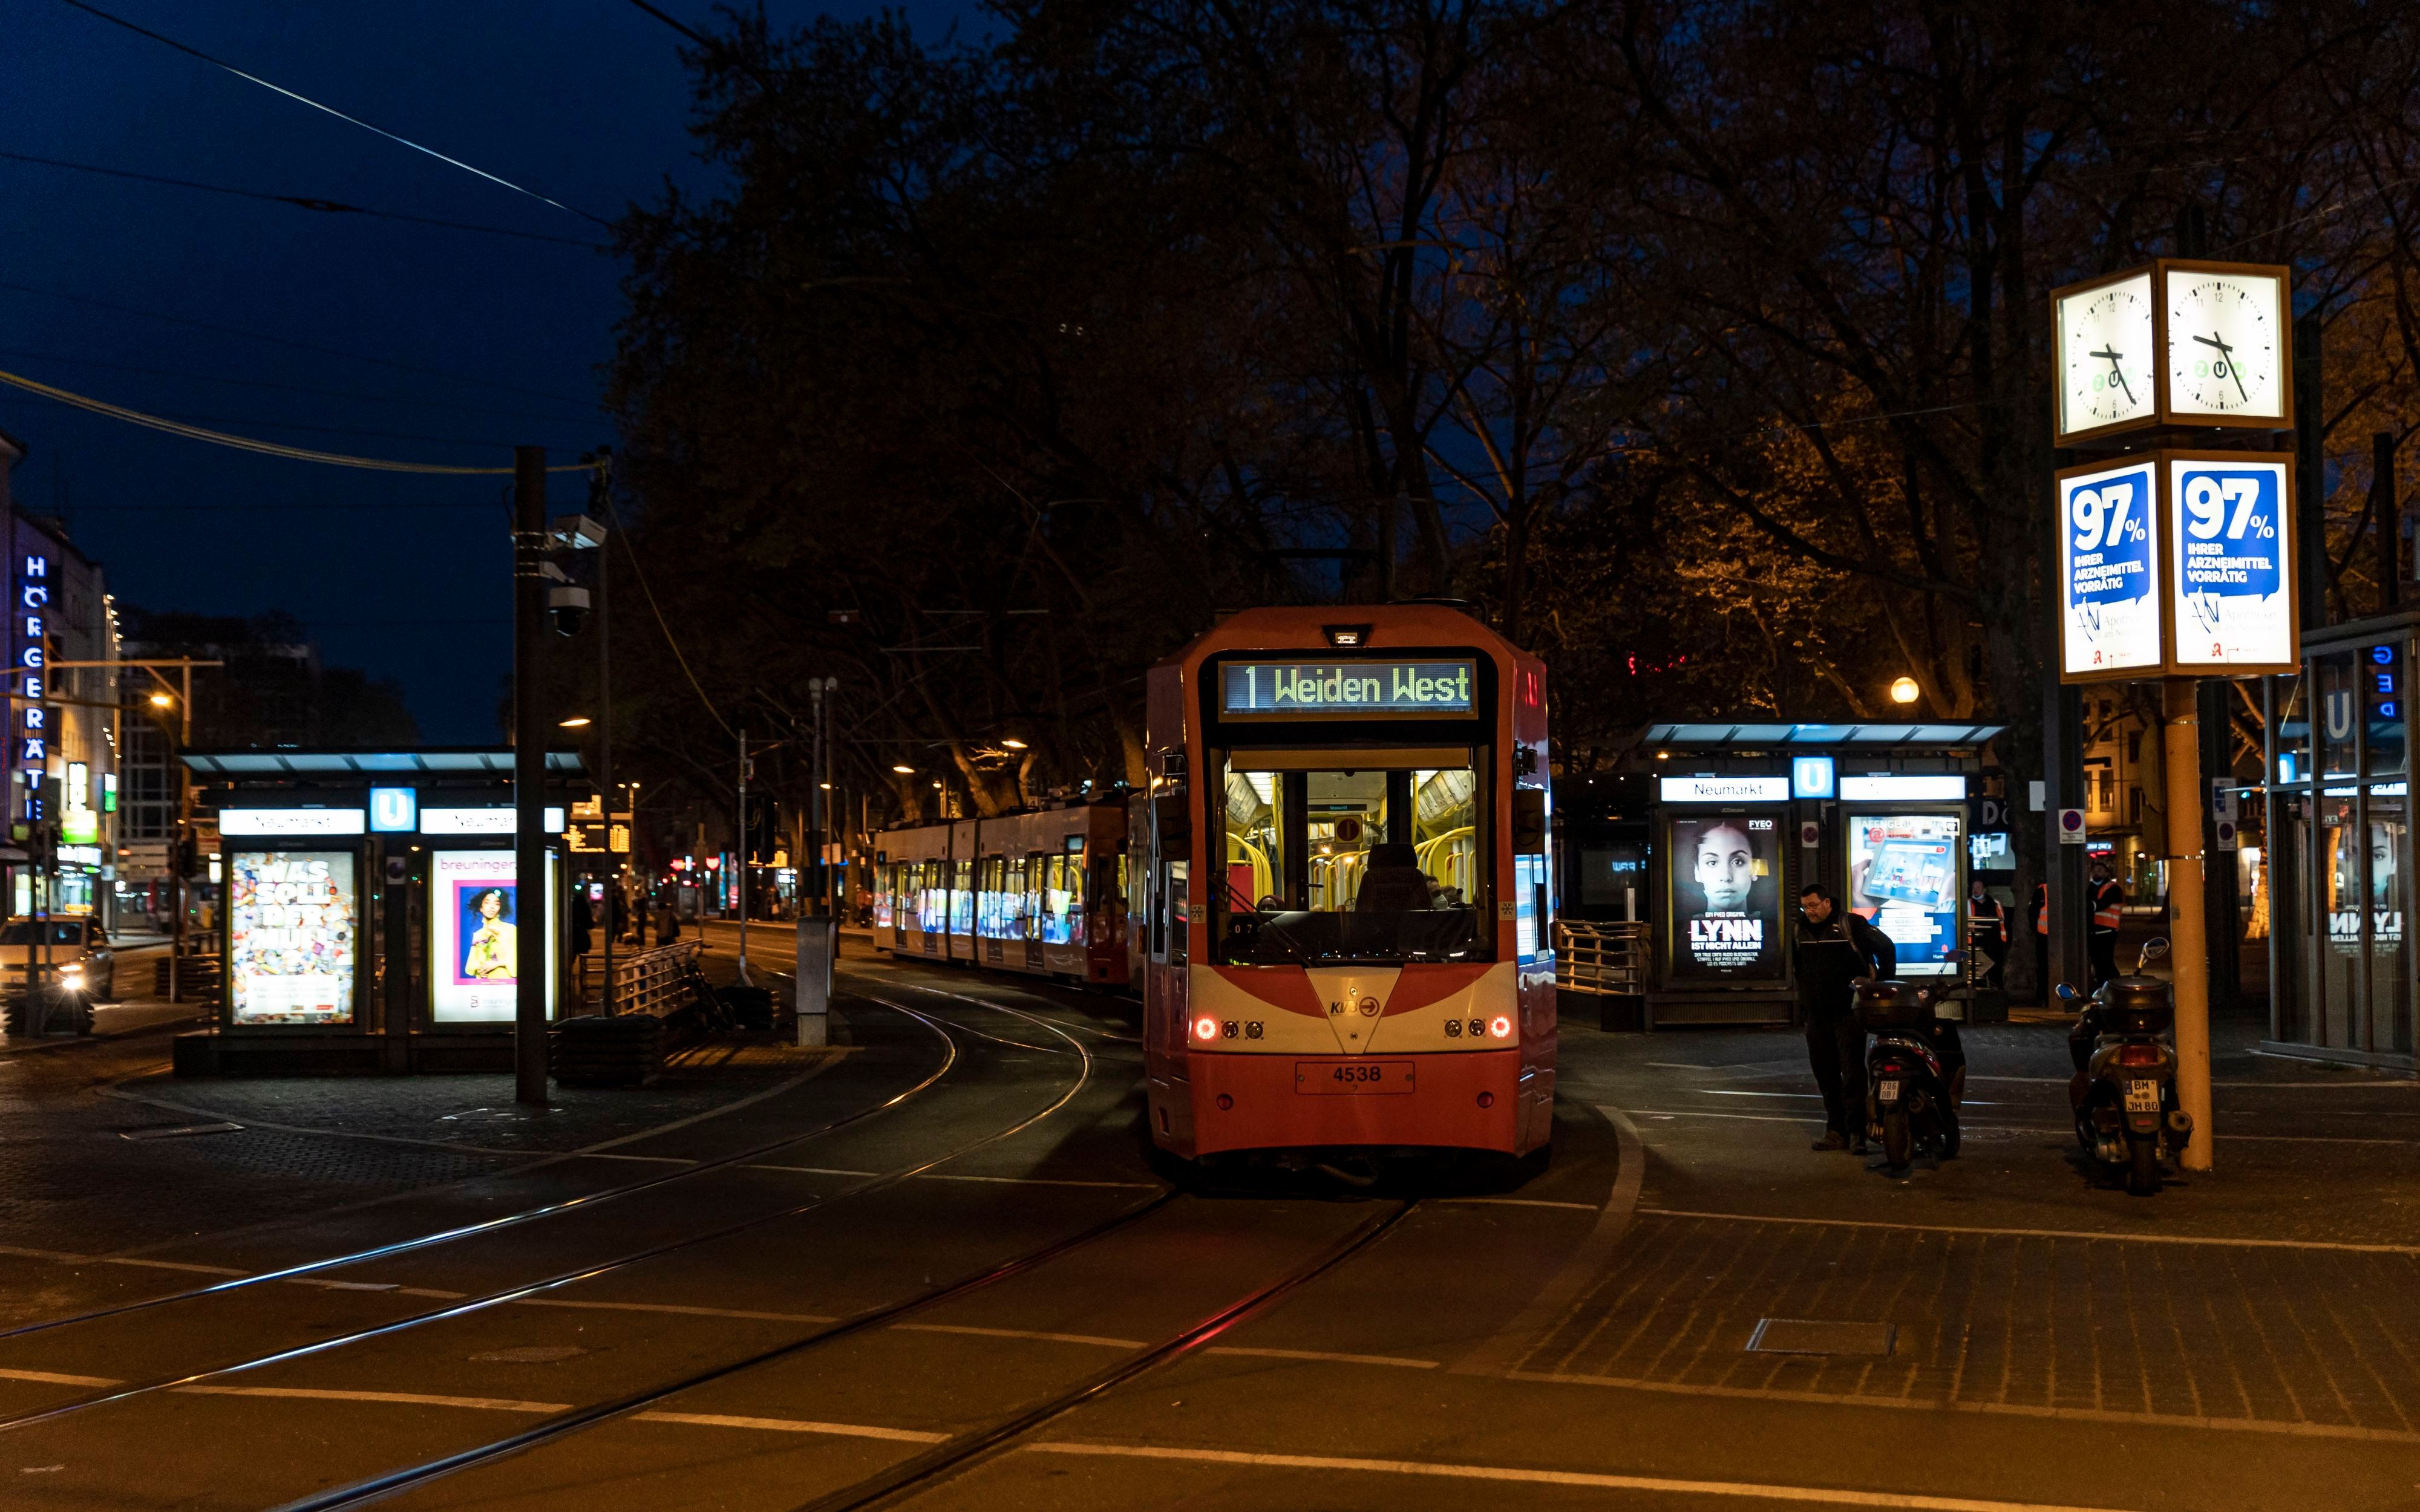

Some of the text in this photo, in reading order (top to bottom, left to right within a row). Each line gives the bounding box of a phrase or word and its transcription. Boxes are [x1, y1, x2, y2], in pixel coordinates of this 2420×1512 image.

[2214, 293, 2223, 303] 12
[2108, 302, 2116, 313] 12
[2216, 363, 2225, 376] U
[2110, 372, 2119, 386] U
[2187, 543, 2224, 556] IHRER
[2073, 551, 2104, 567] IHRER
[2187, 555, 2272, 570] ARZNEIMITTEL
[2073, 560, 2144, 582] ARZNEIMITTEL
[2186, 569, 2247, 583] VORRÄTIG
[2073, 576, 2124, 594] VORRÄTIG
[1245, 665, 1470, 709] 1 Weiden West
[2327, 692, 2350, 740] U
[1799, 763, 1828, 793] U
[1694, 782, 1763, 797] Neumarkt
[378, 794, 408, 827] U
[1748, 820, 1773, 828] FYEO
[259, 861, 330, 884] WAS
[255, 882, 332, 905] SOLL
[260, 904, 324, 928] DER
[1690, 919, 1762, 942] LYNN
[1691, 942, 1705, 950] IST
[1705, 942, 1732, 950] NICHT
[1333, 1066, 1382, 1083] 4538
[2134, 1080, 2150, 1090] BM
